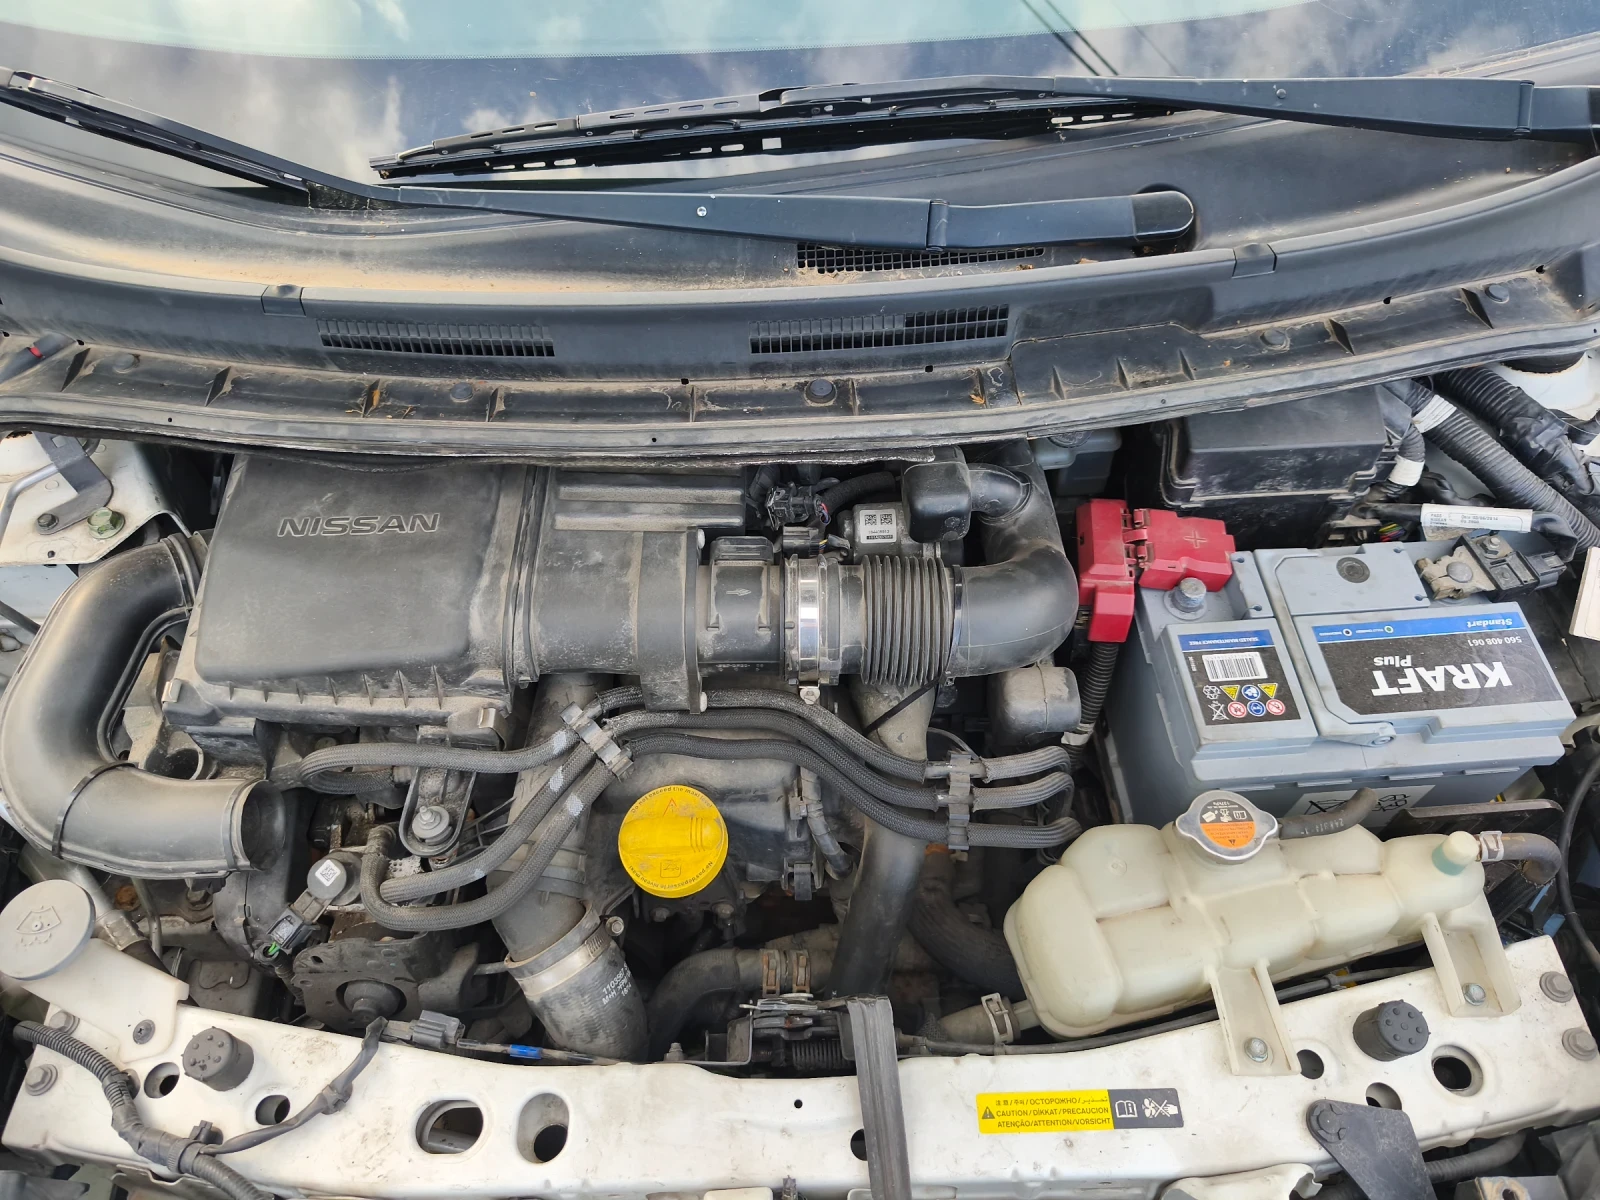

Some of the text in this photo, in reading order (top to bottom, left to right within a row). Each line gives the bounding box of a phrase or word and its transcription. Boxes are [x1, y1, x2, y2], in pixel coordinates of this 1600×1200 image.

[277, 513, 440, 538] NISSAN
[1466, 617, 1513, 628] Standart
[1505, 636, 1522, 644] 560
[1373, 654, 1412, 668] Plus
[1371, 661, 1513, 697] KRAFT
[648, 787, 672, 798] exceed
[996, 1109, 1028, 1117] CAUTION
